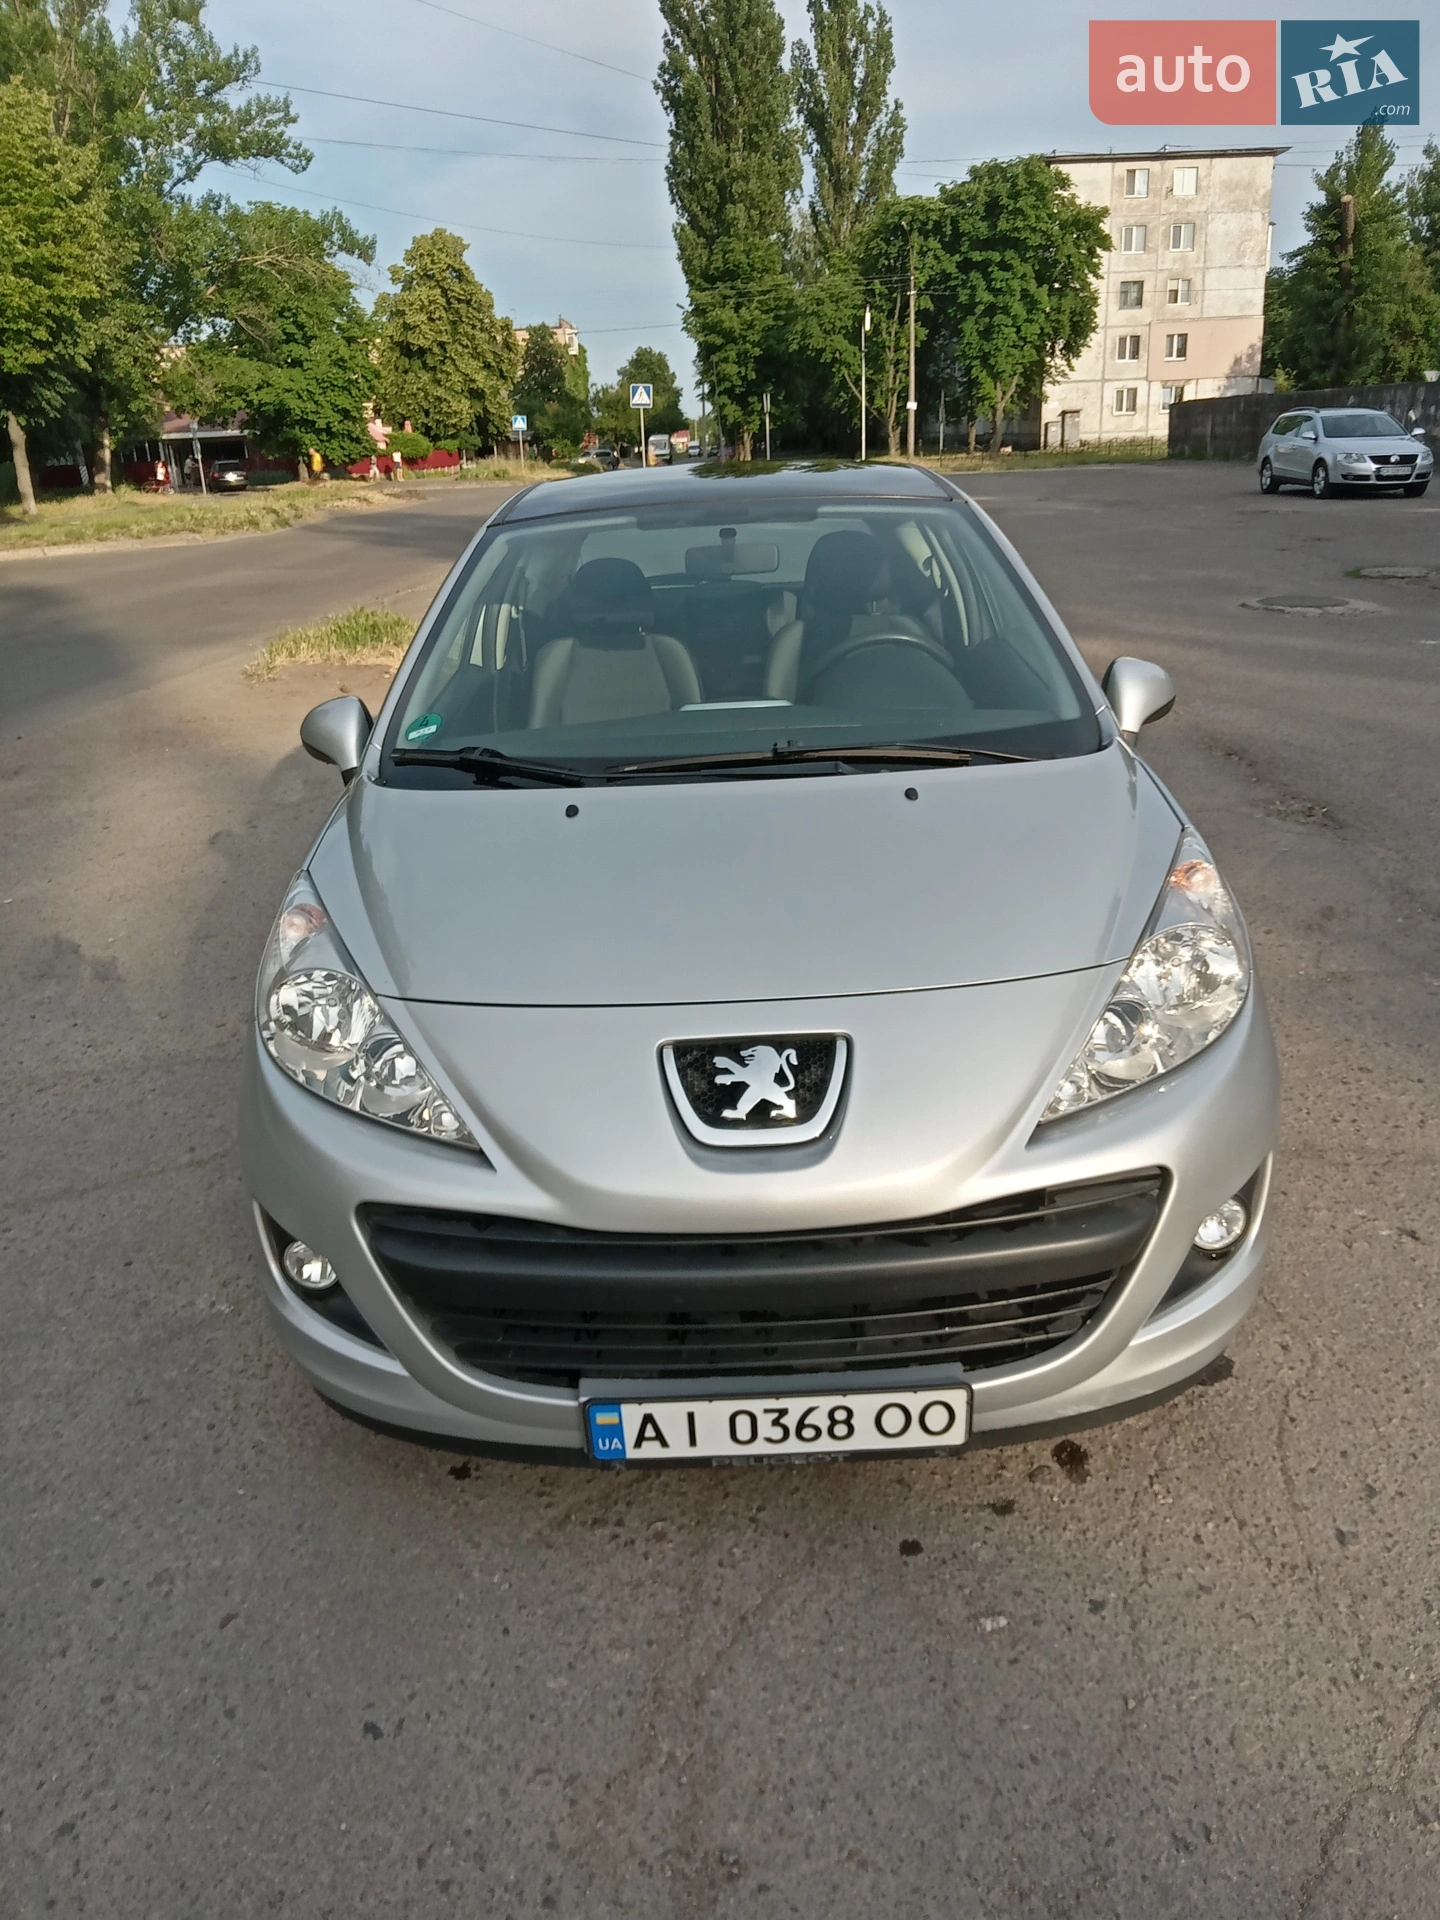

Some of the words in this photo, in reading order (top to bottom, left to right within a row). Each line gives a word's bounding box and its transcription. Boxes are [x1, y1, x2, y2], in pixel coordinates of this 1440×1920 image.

[633, 1411, 697, 1450] AI
[728, 1405, 855, 1446] 0368
[874, 1400, 956, 1439] OO
[598, 1437, 623, 1451] UA
